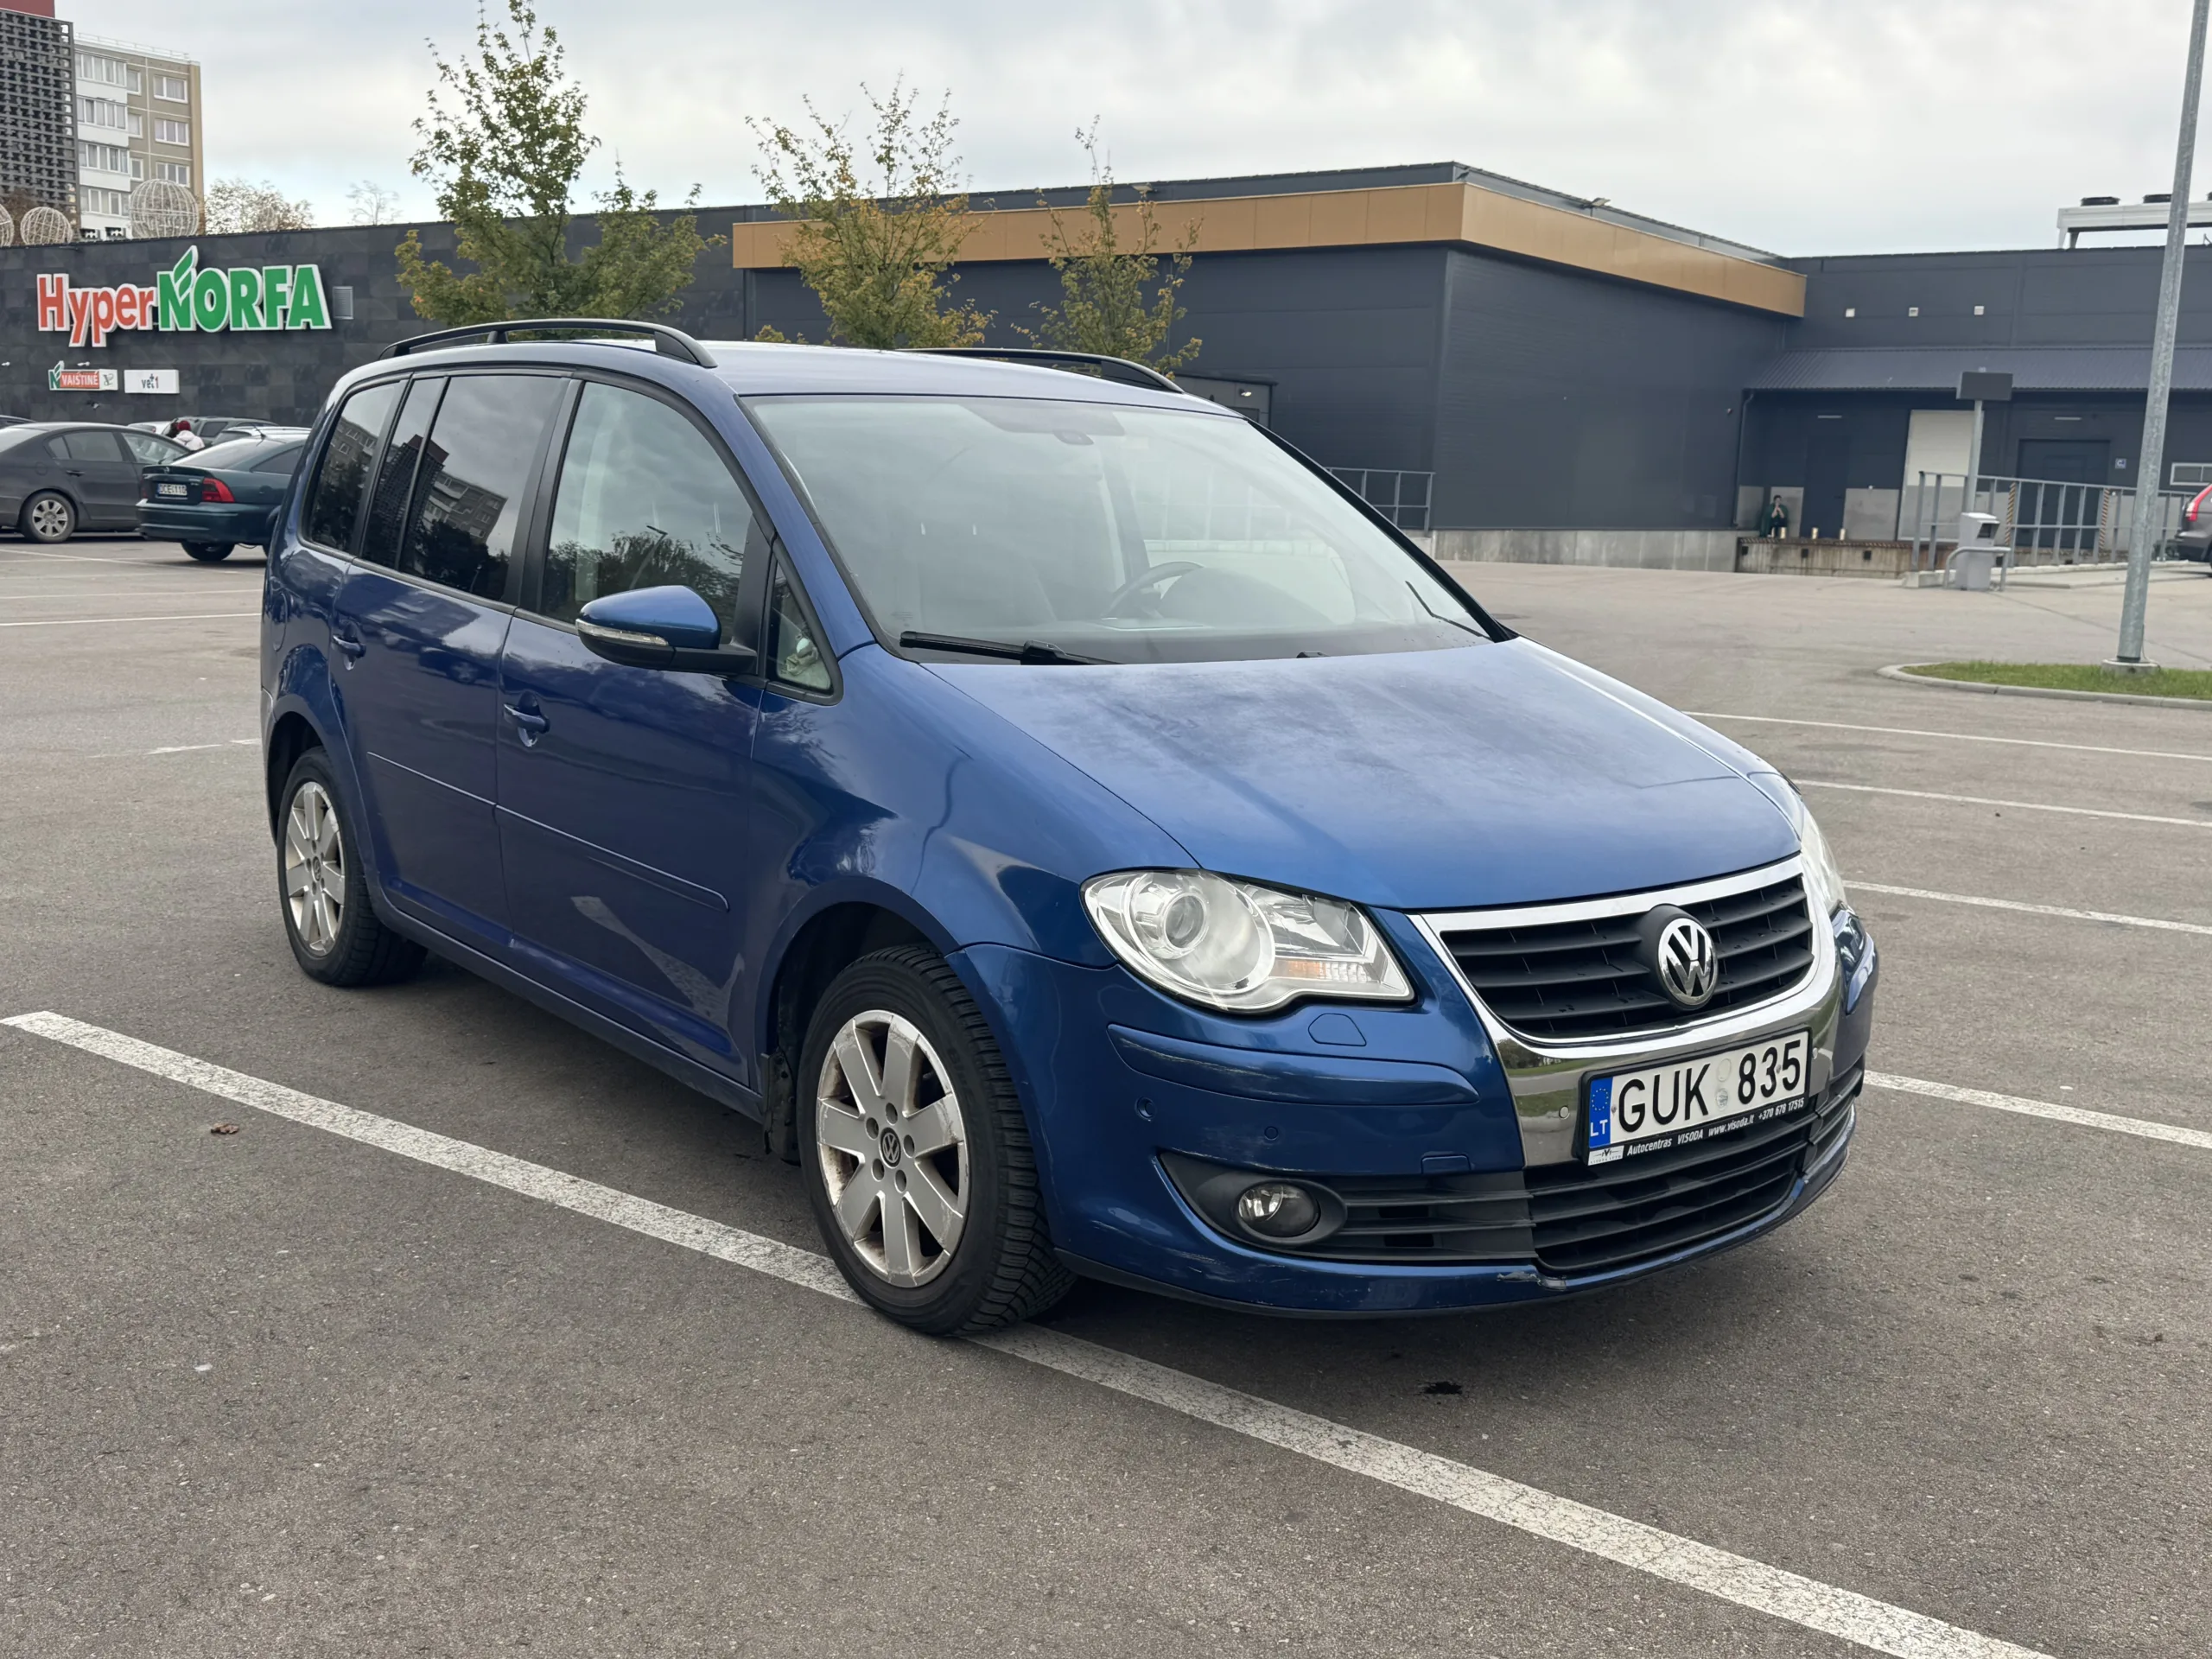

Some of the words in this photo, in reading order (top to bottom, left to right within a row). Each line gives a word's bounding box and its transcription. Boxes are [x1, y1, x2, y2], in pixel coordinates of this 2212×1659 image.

[1618, 1063, 1711, 1133] GUK
[1738, 1039, 1802, 1104] 835
[1591, 1119, 1608, 1136] LT
[1627, 1138, 1672, 1156] Autocentras
[1677, 1129, 1703, 1145] VISODA
[1708, 1114, 1755, 1137] www.visoda.lt
[1758, 1107, 1773, 1120] +370
[1775, 1103, 1786, 1116] 678
[1788, 1097, 1805, 1112] 17515
